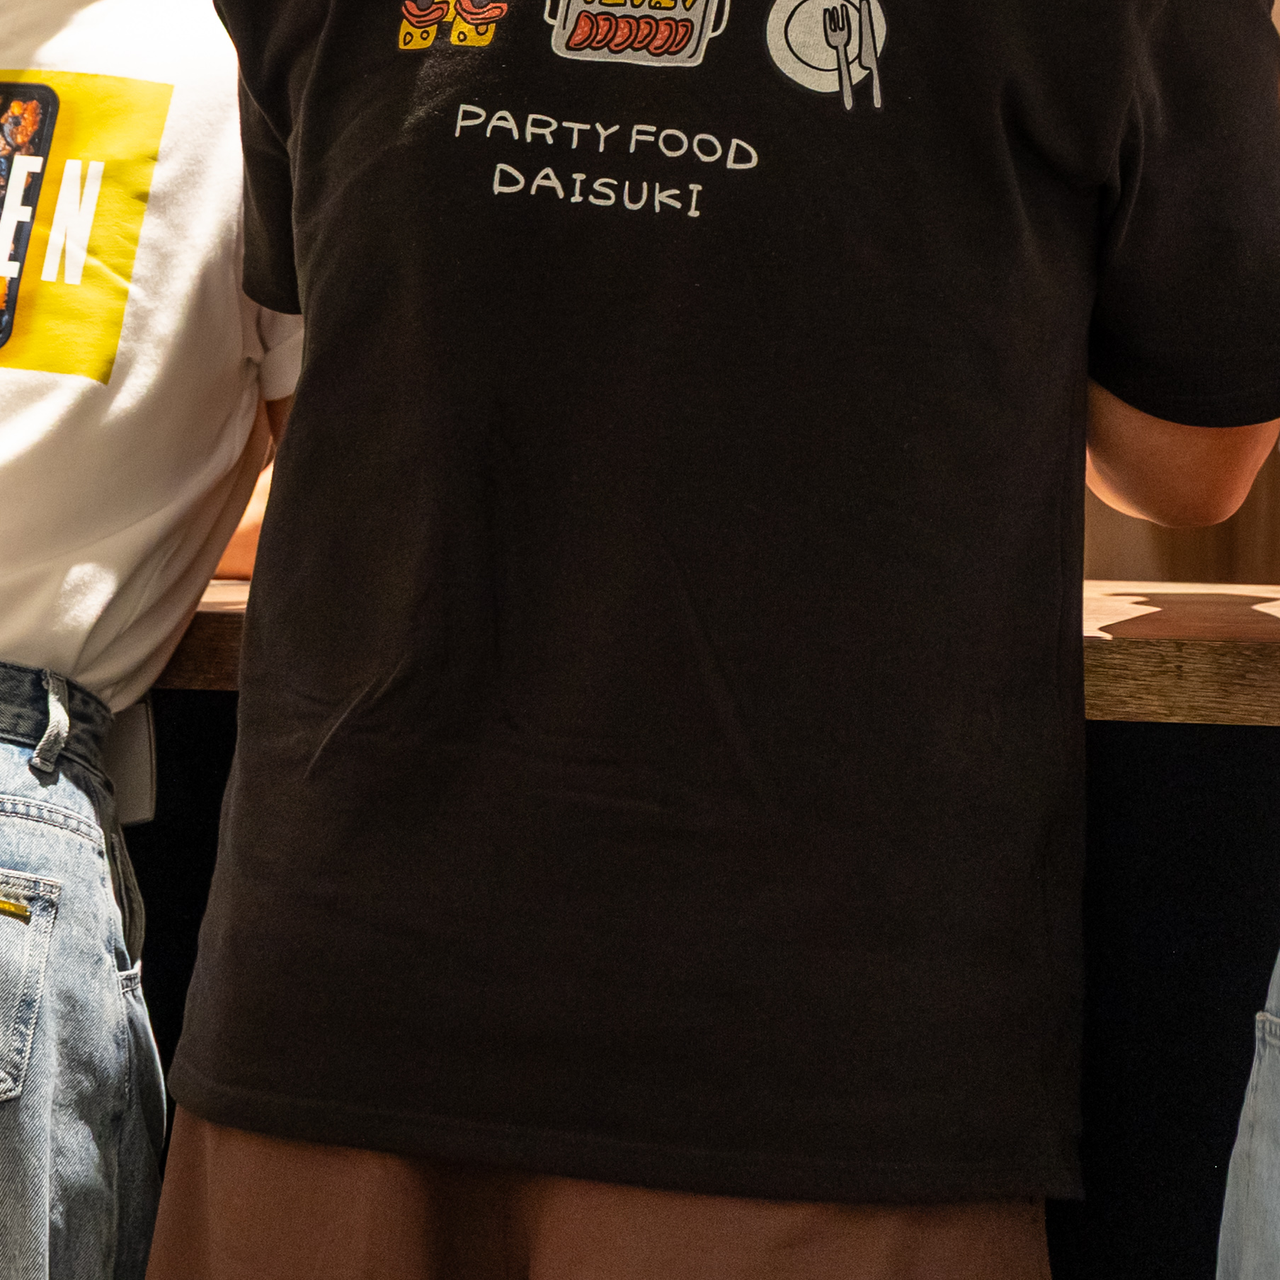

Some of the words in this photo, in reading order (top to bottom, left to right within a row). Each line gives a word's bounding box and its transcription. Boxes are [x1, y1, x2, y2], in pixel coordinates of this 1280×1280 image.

[454, 104, 620, 153] PARTY
[628, 124, 759, 169] FOOD
[492, 163, 703, 218] DAISUKI
